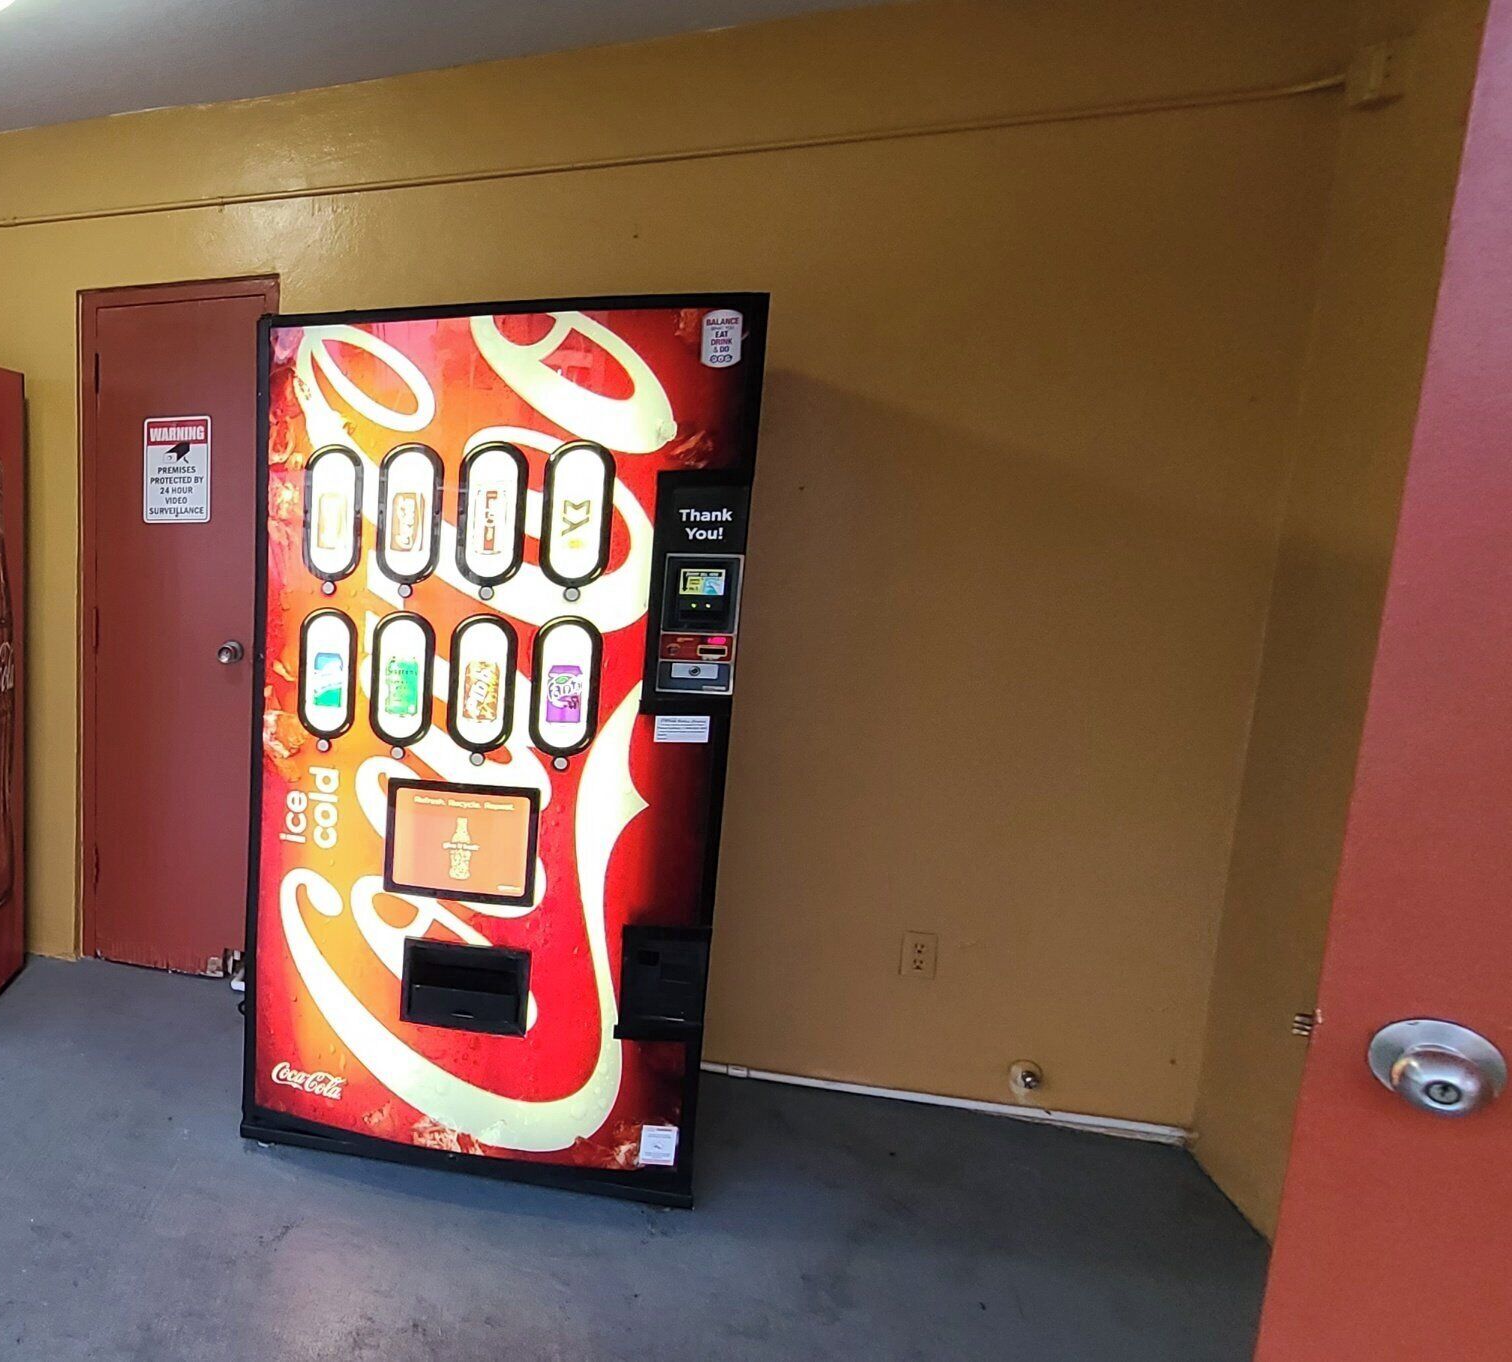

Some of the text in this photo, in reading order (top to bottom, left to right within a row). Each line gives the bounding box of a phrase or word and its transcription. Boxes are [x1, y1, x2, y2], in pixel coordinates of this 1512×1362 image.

[706, 317, 739, 326] BALANCE
[715, 330, 728, 338] EAT
[711, 338, 732, 346] DRINK
[149, 426, 205, 442] WARNING
[157, 466, 196, 475] PREMISES
[150, 476, 204, 485] PROTECTED BY
[159, 486, 193, 495] 24 HOUR
[165, 496, 188, 505] VIDEO
[149, 506, 204, 515] SURVEILLANCE
[678, 508, 733, 522] Thank
[685, 527, 724, 540] You!
[308, 766, 340, 849] cold
[279, 790, 307, 844] ice
[271, 1061, 347, 1100] Coca-Cola
